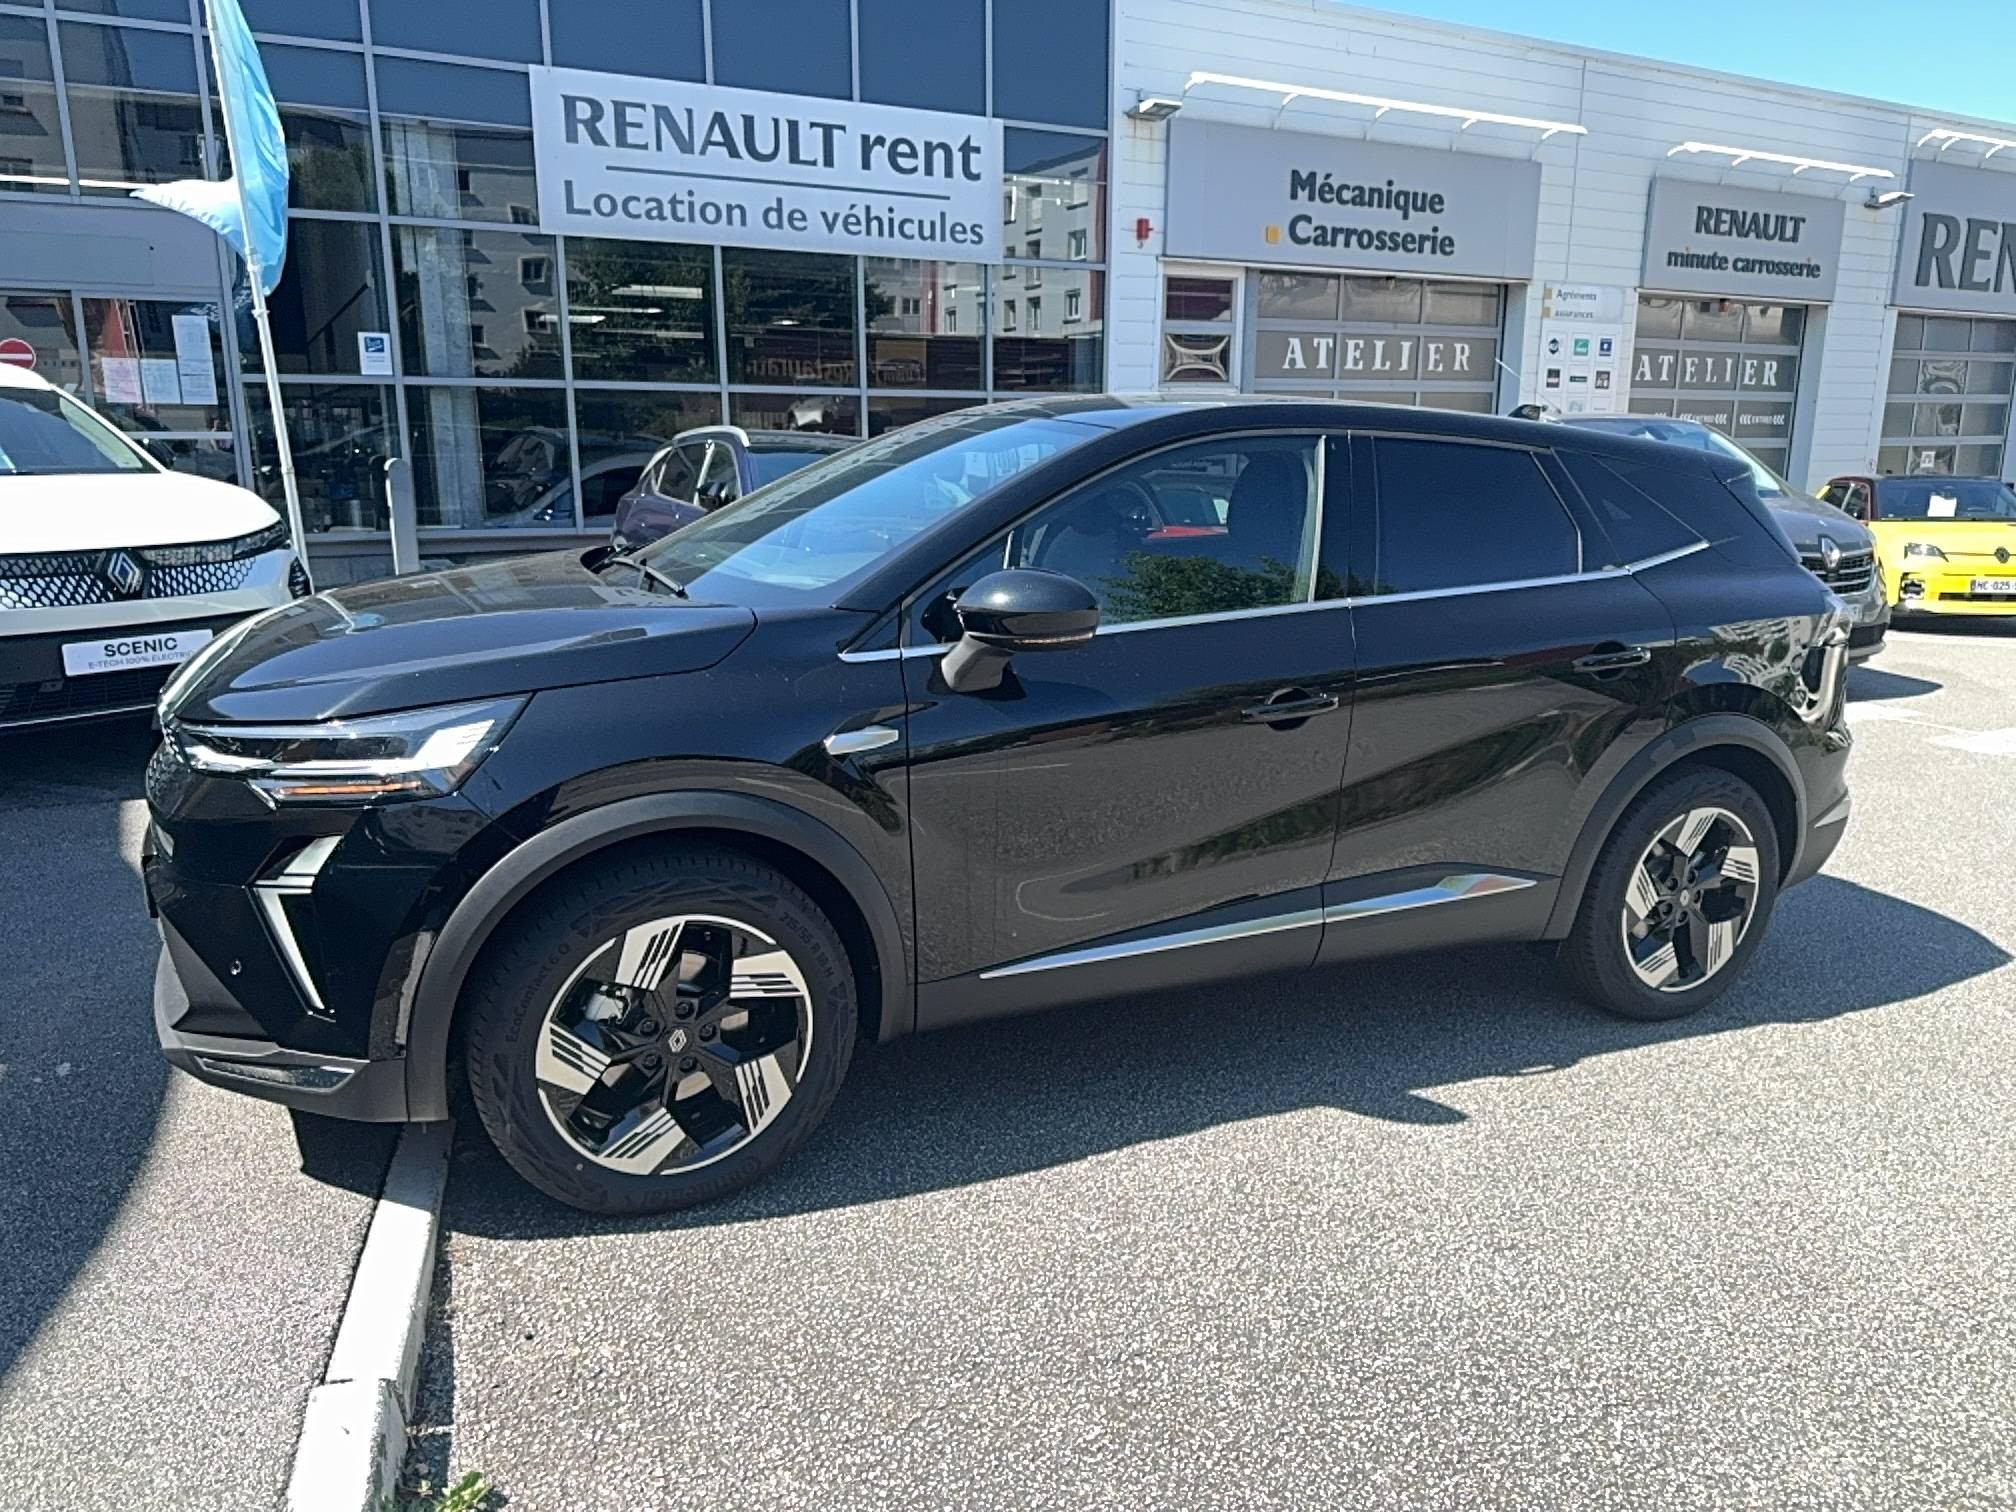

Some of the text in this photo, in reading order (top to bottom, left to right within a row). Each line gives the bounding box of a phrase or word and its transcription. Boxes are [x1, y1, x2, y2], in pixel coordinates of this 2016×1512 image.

[560, 93, 982, 181] RENAULT rent
[564, 180, 985, 246] Location de véhicules
[1289, 169, 1445, 220] Mécanique
[1288, 214, 1455, 256] Carrosserie
[1695, 205, 1806, 243] RENAULT
[1666, 246, 1821, 279] minute carrosserie
[1282, 337, 1470, 372] ATELIER
[1634, 354, 1778, 386] ATELIER
[104, 637, 178, 657] SCENIC
